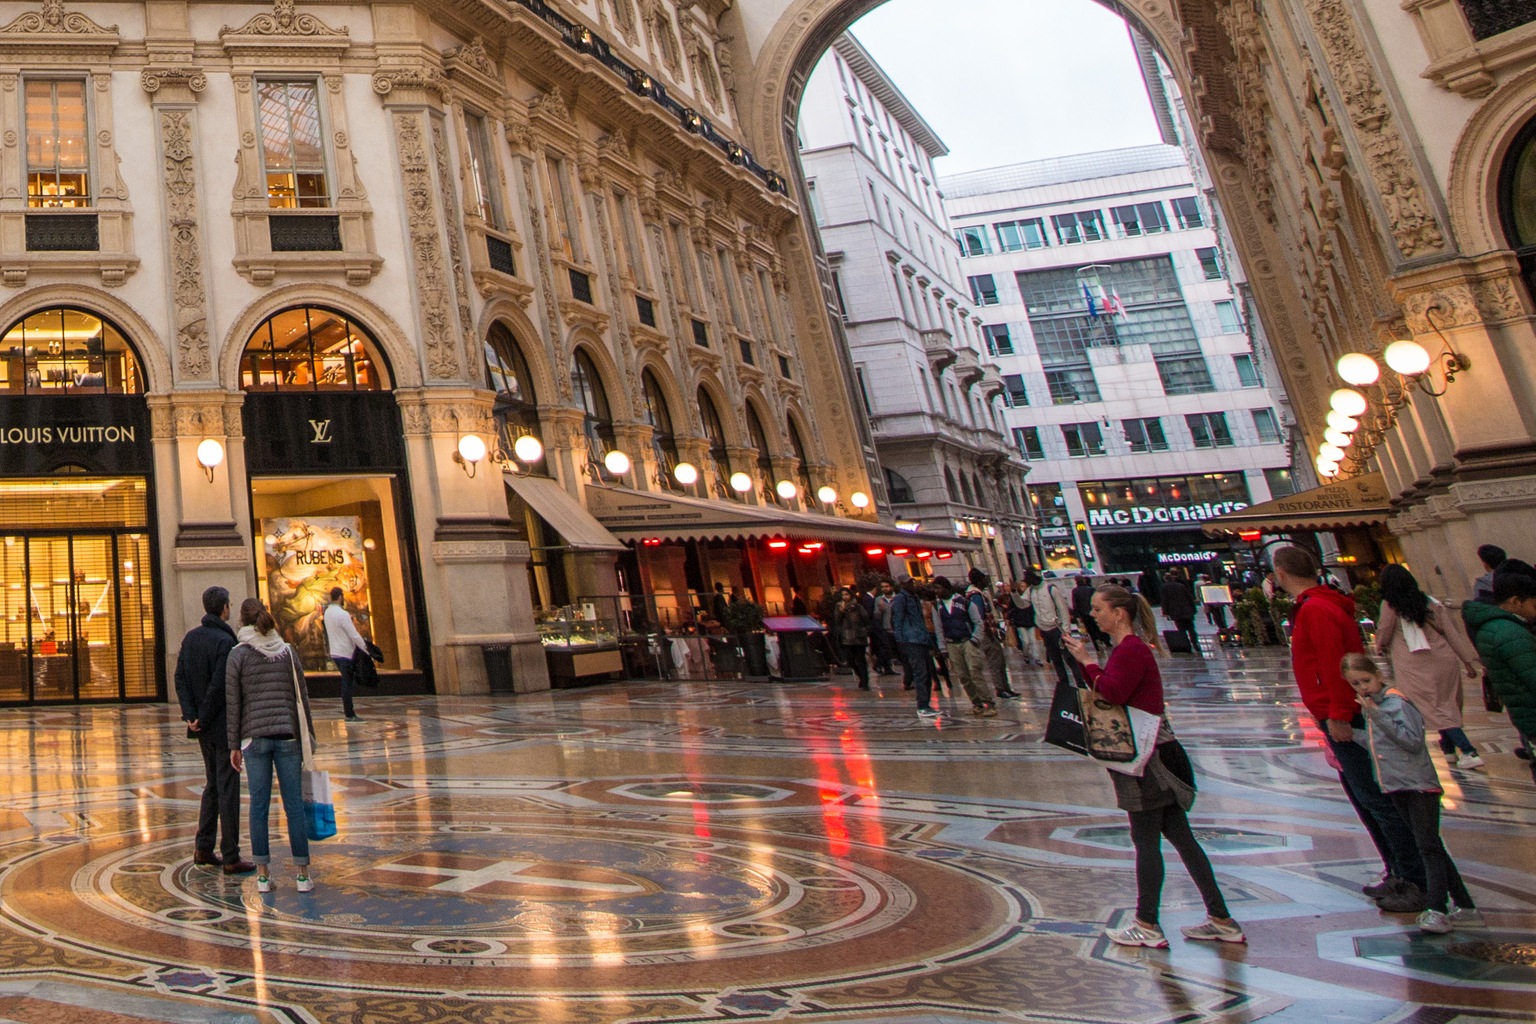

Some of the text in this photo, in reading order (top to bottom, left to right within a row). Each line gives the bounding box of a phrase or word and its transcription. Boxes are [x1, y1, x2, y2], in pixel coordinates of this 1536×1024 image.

[0, 426, 135, 444] LOUIS VUITTON
[1317, 492, 1350, 501] BISTROT
[1325, 486, 1348, 494] PIZZA
[1278, 499, 1353, 512] RISTORANTE
[1089, 501, 1249, 526] McDonald's
[296, 549, 345, 565] RUBENS
[1158, 551, 1218, 563] McDonald's
